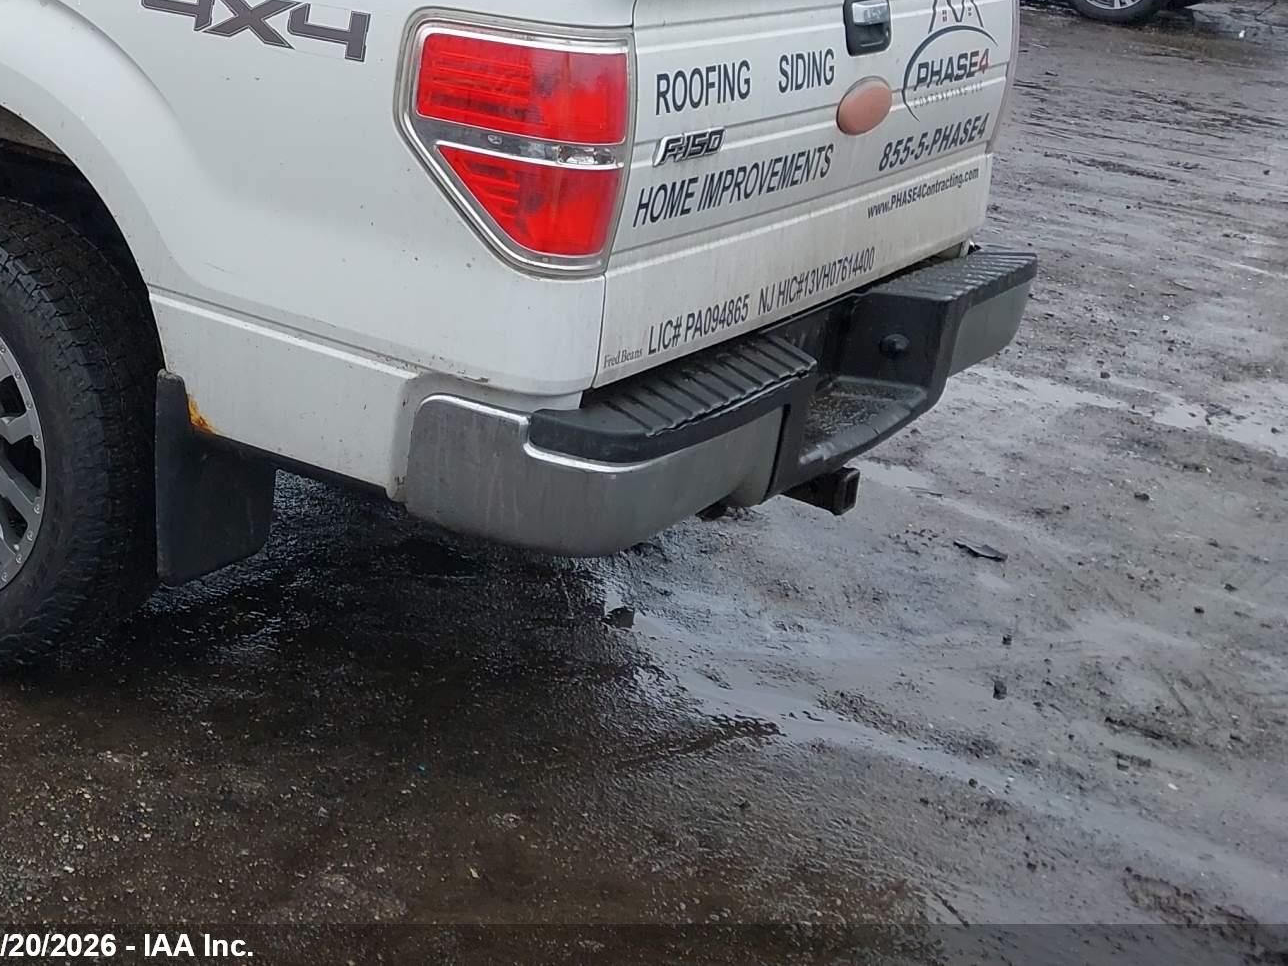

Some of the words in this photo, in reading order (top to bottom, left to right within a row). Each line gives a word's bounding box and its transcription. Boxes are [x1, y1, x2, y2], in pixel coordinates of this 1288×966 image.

[655, 59, 752, 116] ROOFING
[778, 48, 836, 94] SIDING
[913, 48, 990, 92] PHASE4
[878, 112, 990, 172] 855-5-PHASE4
[632, 176, 699, 228] HOME
[697, 143, 835, 212] IMPROVEMENTS
[866, 167, 980, 219] www.PHASE4Contracting.com
[647, 320, 683, 356] LIC#
[684, 293, 751, 343] PA094865
[757, 283, 776, 316] NJ
